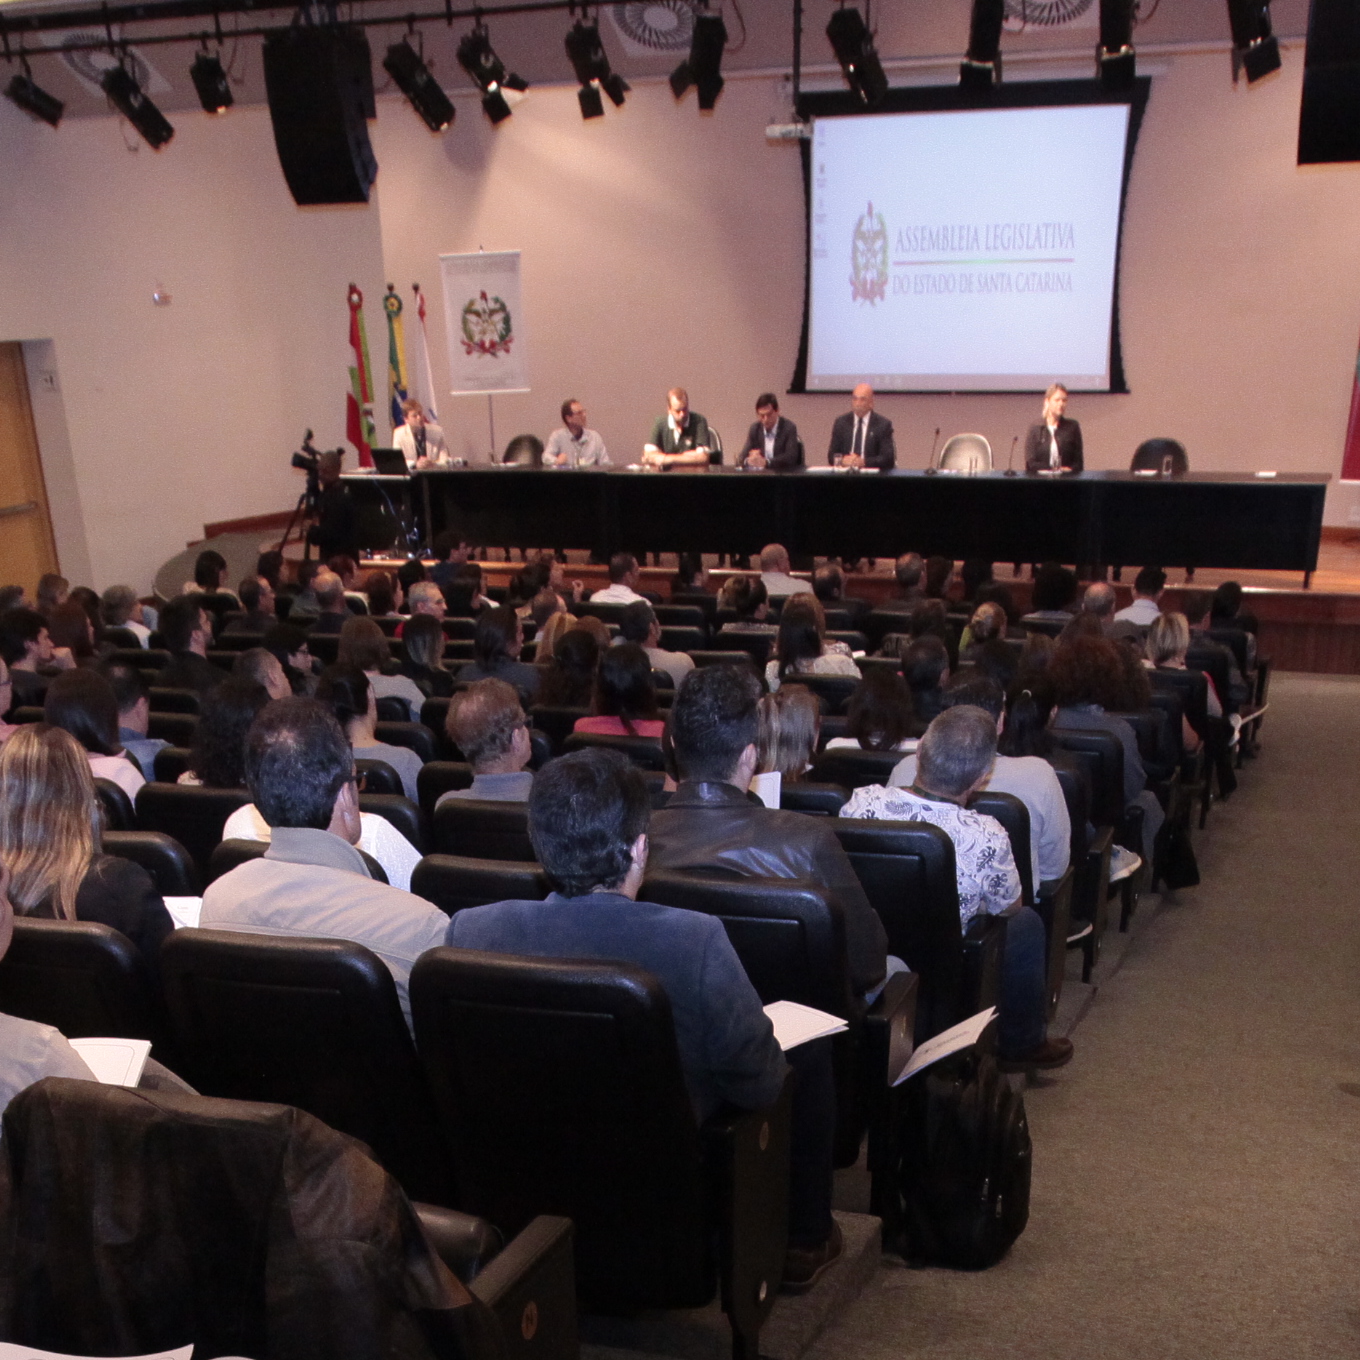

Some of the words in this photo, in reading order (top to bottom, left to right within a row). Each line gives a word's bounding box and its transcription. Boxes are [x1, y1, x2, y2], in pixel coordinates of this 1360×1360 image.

[895, 226, 979, 252] ASSEMBLEIA
[985, 222, 1075, 251] LEGISLATIVA
[893, 274, 911, 294] DO
[914, 273, 956, 294] ESTADO
[959, 273, 974, 293] DE
[977, 272, 1012, 292] SANTA
[1015, 271, 1072, 292] CATARINA
